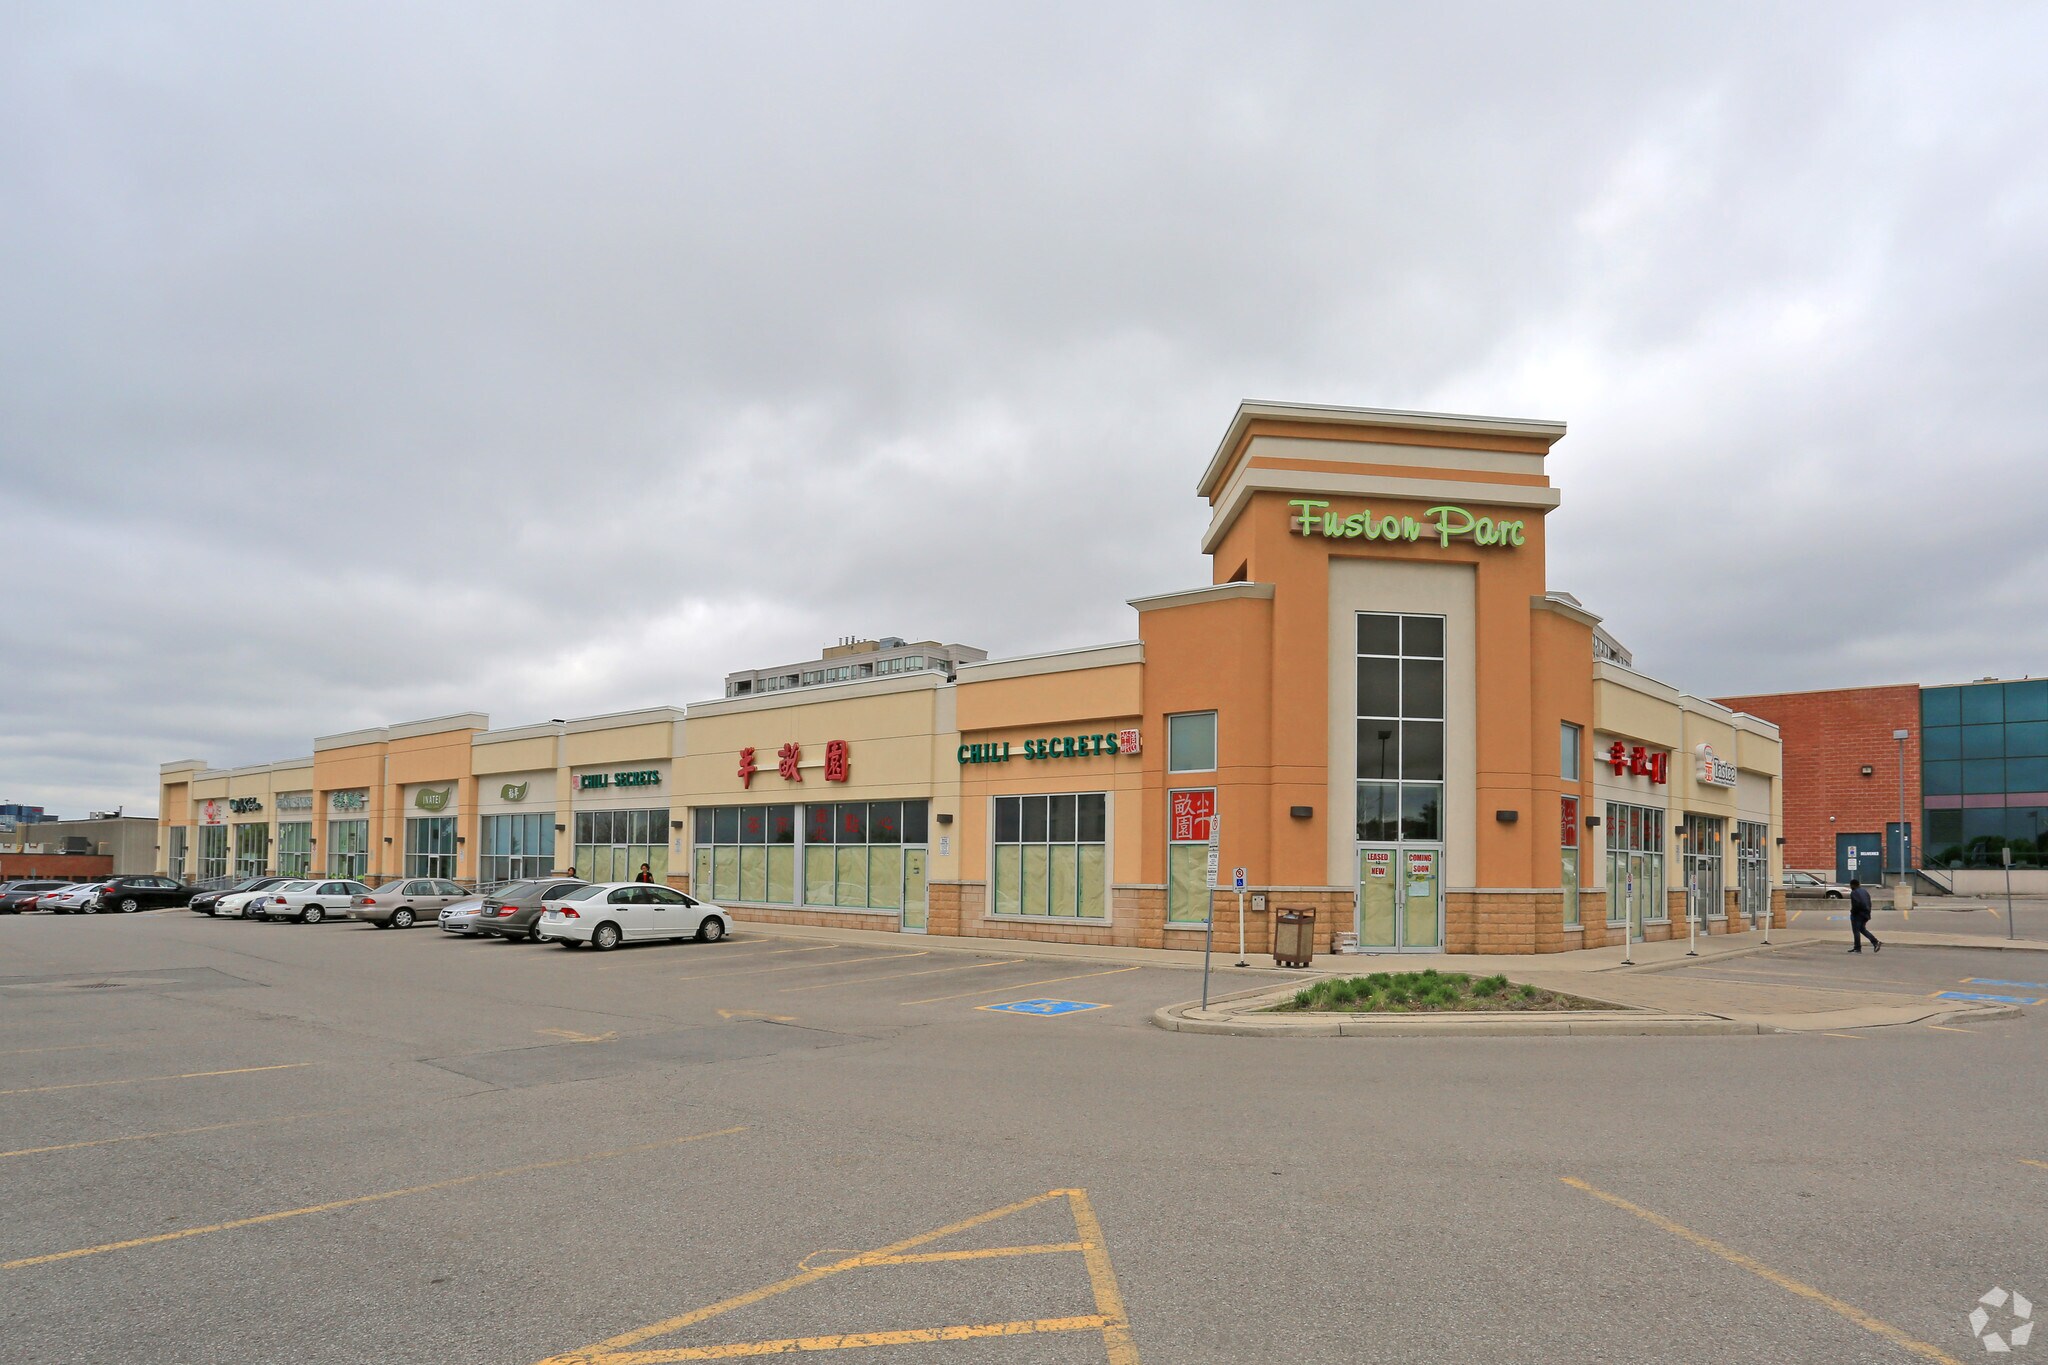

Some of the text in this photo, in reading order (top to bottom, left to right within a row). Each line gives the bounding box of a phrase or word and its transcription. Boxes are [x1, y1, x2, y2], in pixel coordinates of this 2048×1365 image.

[1288, 499, 1526, 548] Fusion Parc
[957, 742, 1010, 765] CHILI
[1023, 732, 1119, 761] SECRETS
[581, 773, 609, 789] CHILI
[614, 769, 661, 788] SECRETS
[1367, 853, 1389, 861] LEASED
[1408, 854, 1432, 862] COMING
[1371, 867, 1385, 875] NEW
[1413, 865, 1430, 873] SOON
